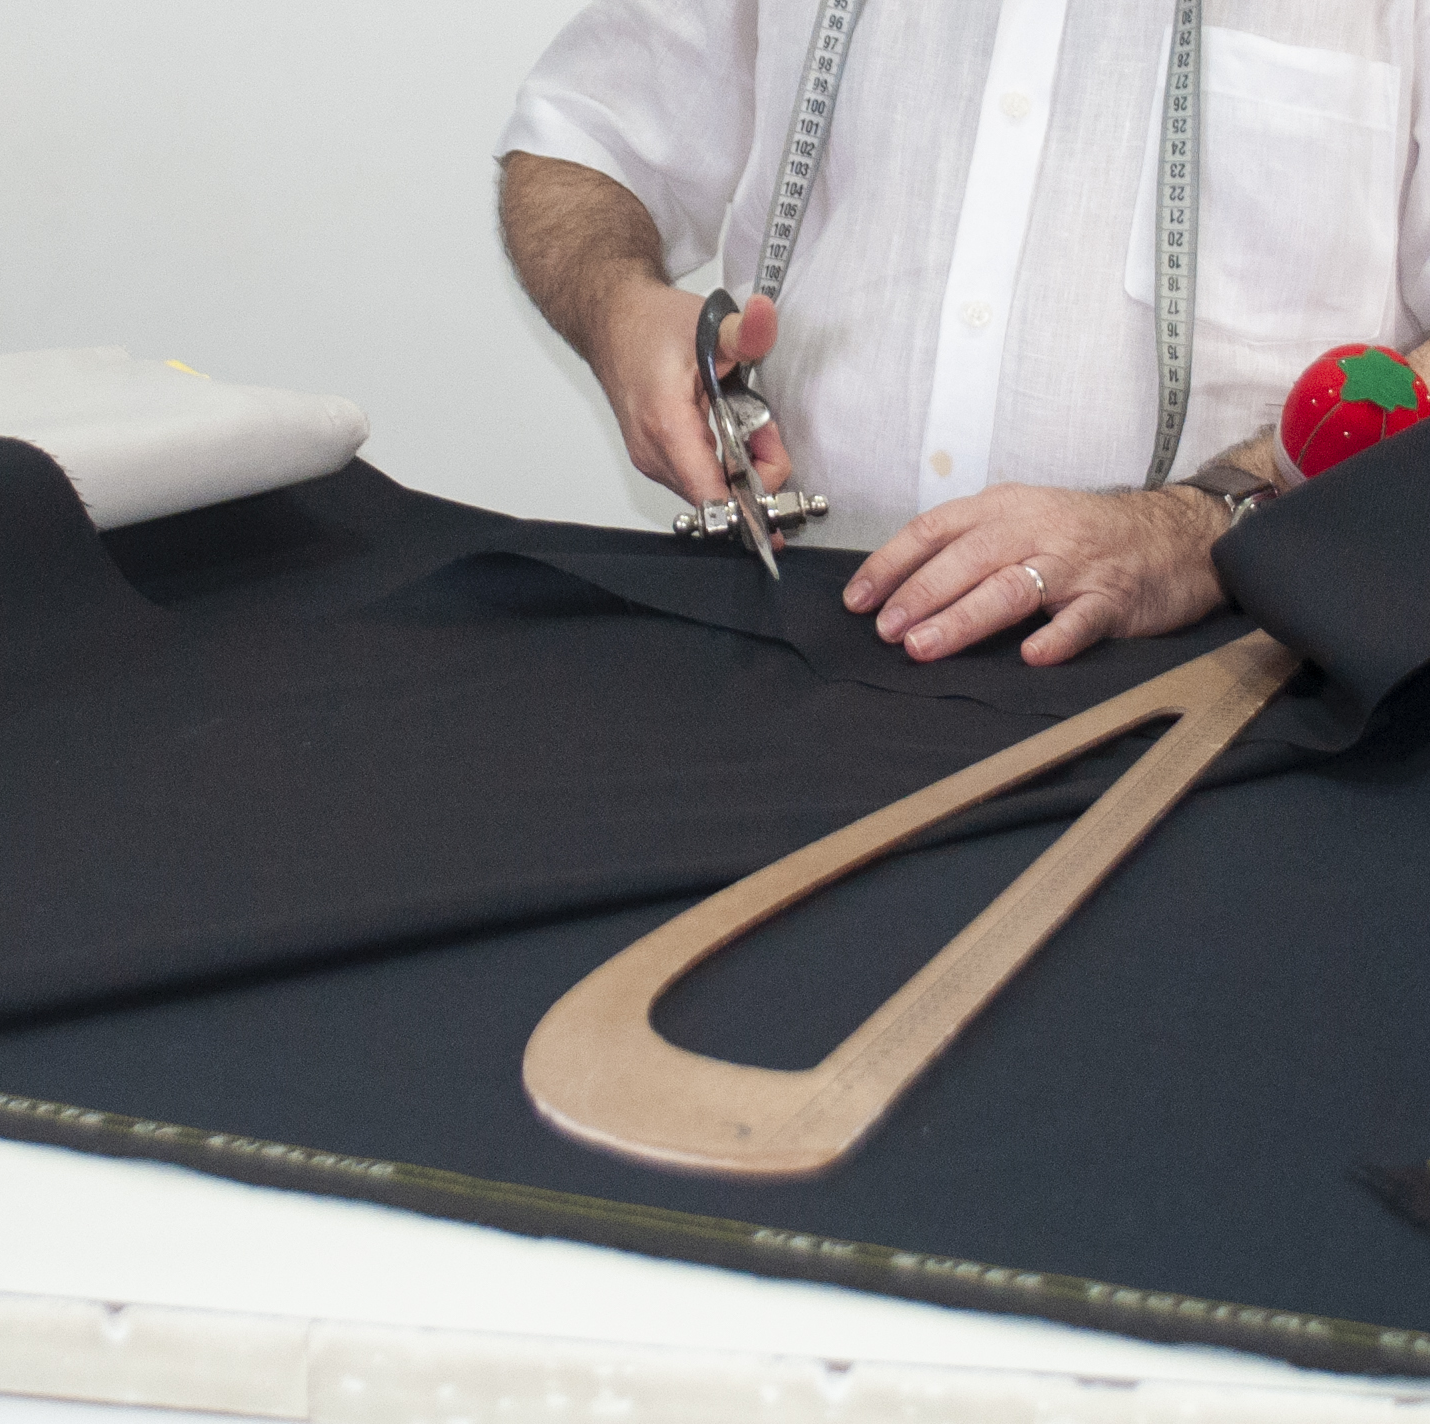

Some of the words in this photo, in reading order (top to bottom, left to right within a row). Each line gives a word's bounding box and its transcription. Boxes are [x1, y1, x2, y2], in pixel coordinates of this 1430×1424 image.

[829, 15, 843, 29] 96
[1182, 9, 1192, 24] 30
[823, 36, 838, 50] 97
[1179, 31, 1191, 46] 29
[818, 57, 832, 71] 98
[1178, 53, 1189, 68] 28
[813, 77, 827, 92] 99
[1175, 75, 1188, 89] 27
[806, 99, 825, 114] 100
[1173, 97, 1187, 111] 26
[800, 119, 819, 134] 101
[1172, 119, 1186, 133] 25
[795, 140, 815, 155] 102
[1171, 141, 1185, 155] 24
[790, 161, 809, 176] 103
[1170, 163, 1185, 178] 23
[784, 182, 802, 197] 104
[1169, 186, 1184, 200] 22
[780, 203, 797, 217] 105
[1169, 209, 1183, 224] 21
[775, 223, 791, 238] 106
[1168, 232, 1183, 246] 20
[770, 244, 786, 258] 107
[1168, 255, 1181, 268] 19
[765, 265, 780, 279] 108
[1168, 277, 1180, 291] 18
[1167, 300, 1179, 314] 17
[1167, 323, 1179, 337] 16
[1167, 346, 1179, 360] 15
[1168, 368, 1179, 382] 14
[1168, 391, 1178, 406] 13
[1165, 414, 1174, 428] 12
